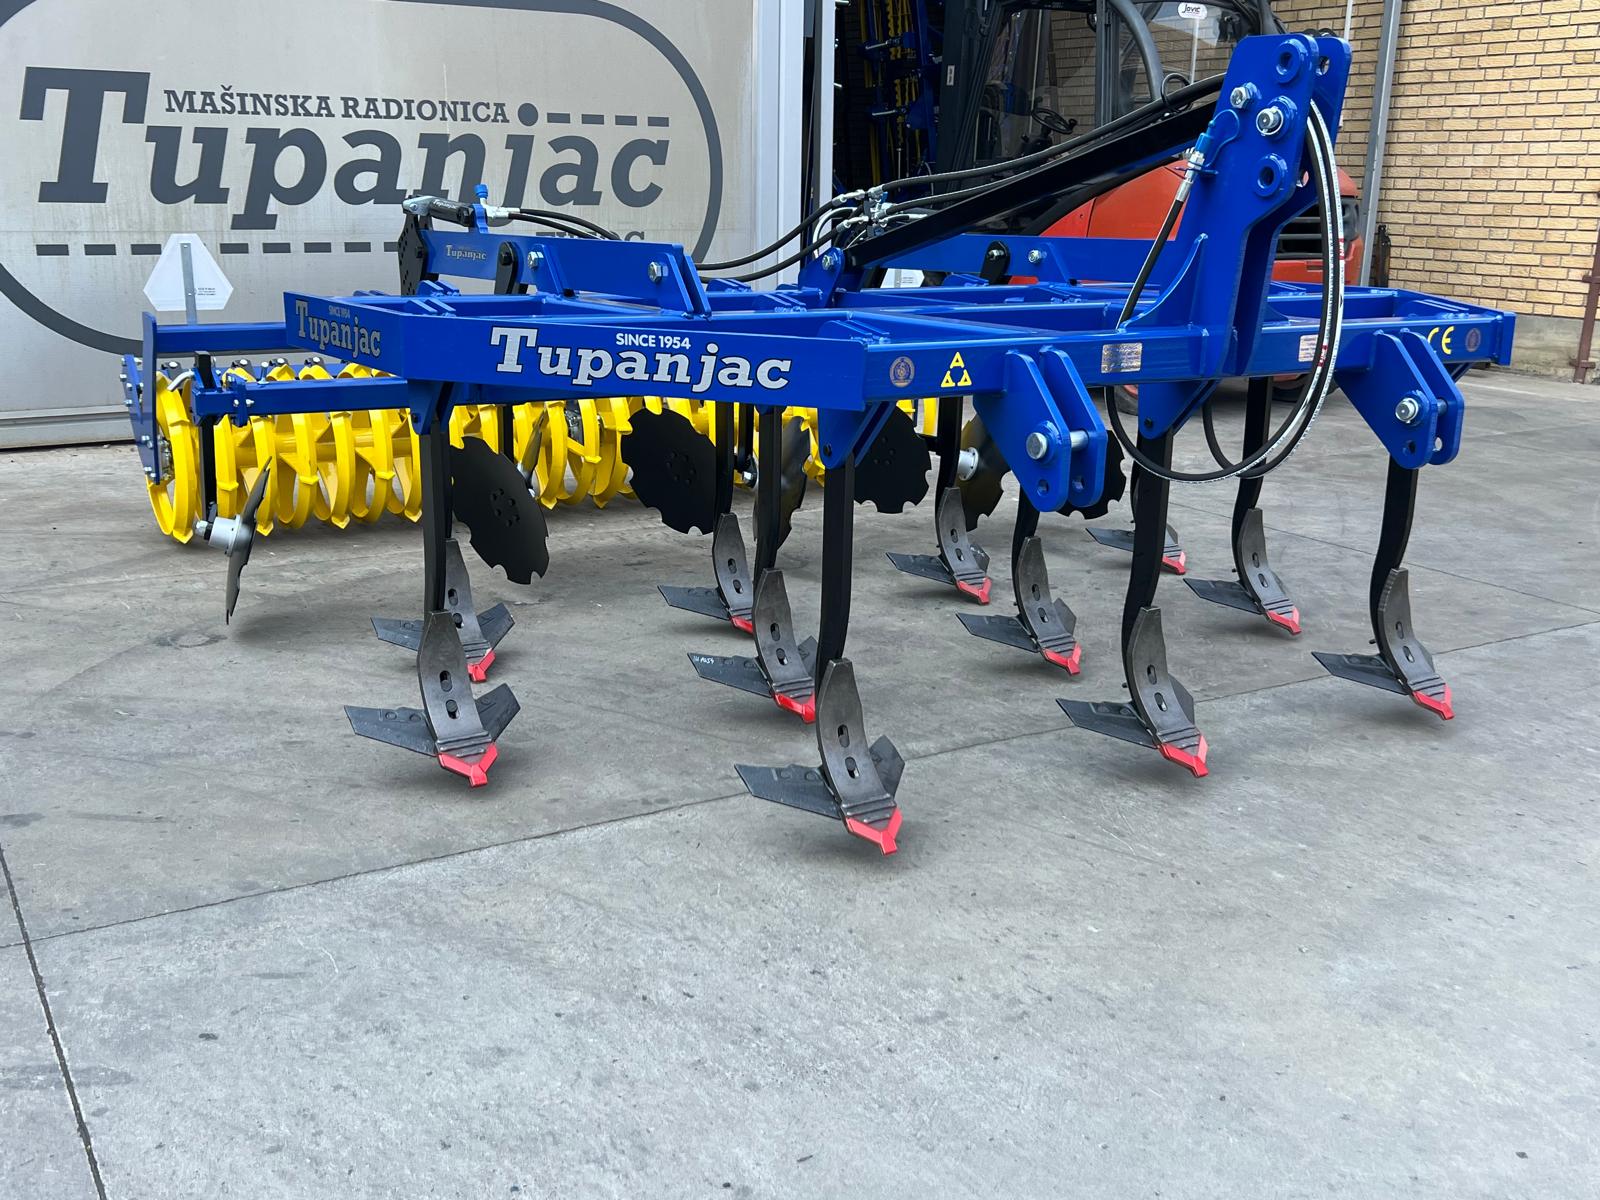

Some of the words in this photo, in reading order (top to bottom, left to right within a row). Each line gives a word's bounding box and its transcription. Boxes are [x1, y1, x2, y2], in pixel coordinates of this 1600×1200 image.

[164, 84, 335, 118] MAŠINSKA
[340, 96, 510, 123] RADIONICA
[20, 66, 670, 229] Tupanjac
[445, 244, 487, 261] Tupanjac
[295, 299, 381, 359] Tupanjac
[615, 333, 657, 348] SINCE
[658, 335, 692, 350] 1954
[490, 326, 792, 393] Tupanjac
